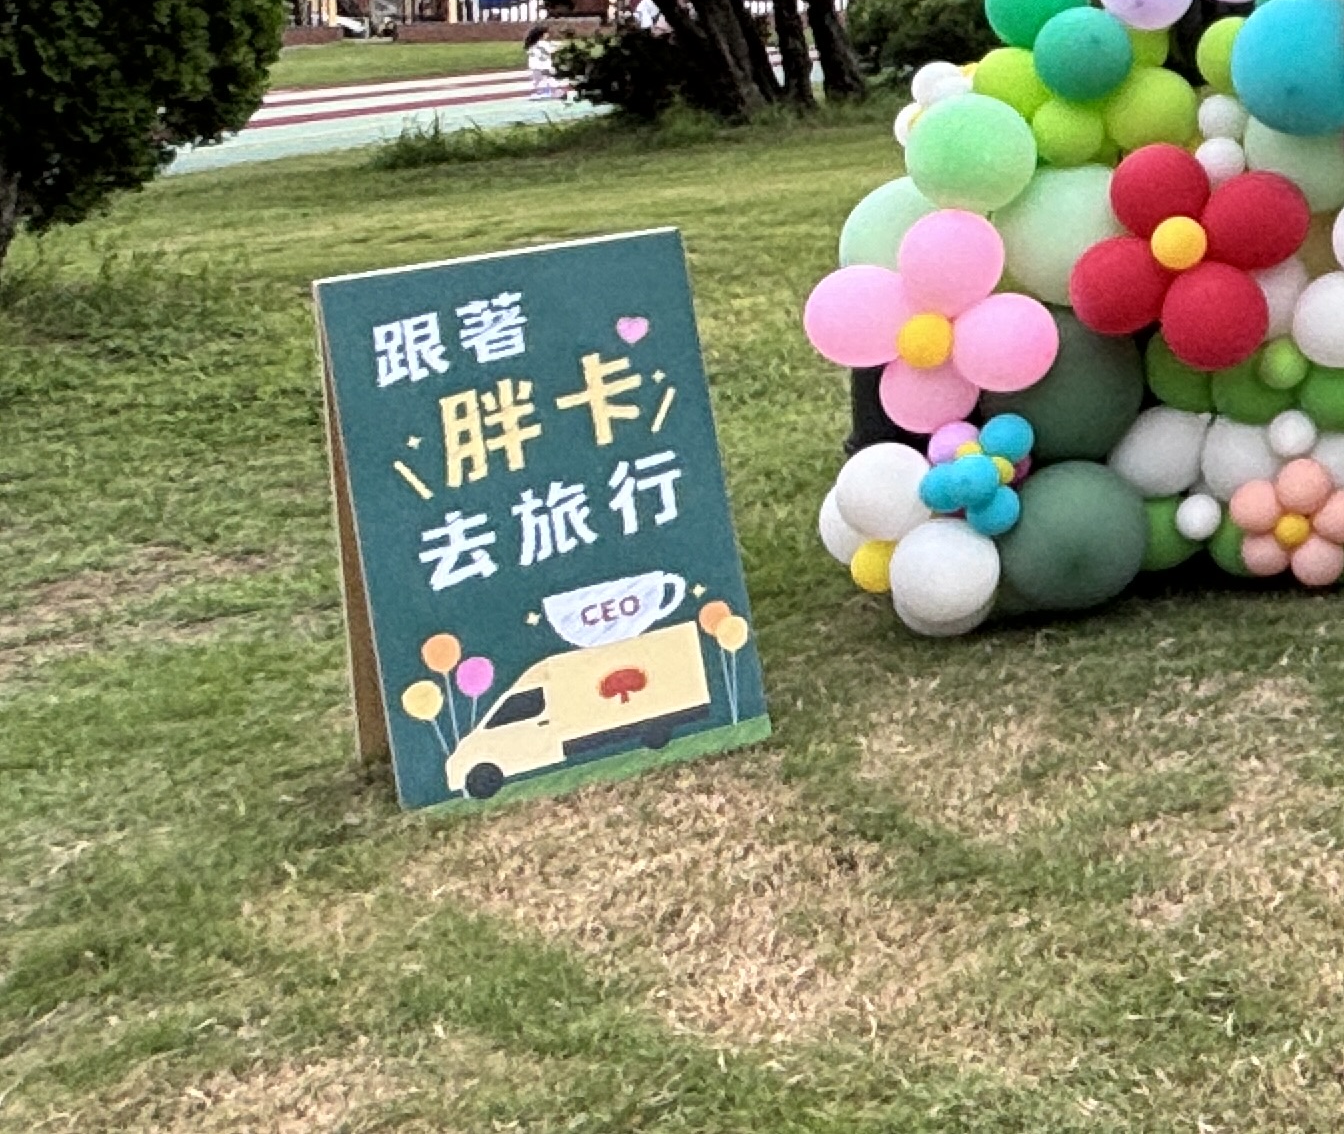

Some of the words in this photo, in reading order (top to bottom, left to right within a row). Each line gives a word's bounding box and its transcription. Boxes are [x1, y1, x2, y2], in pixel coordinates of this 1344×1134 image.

[371, 291, 529, 389] 跟著
[439, 351, 643, 489] 胖卡
[418, 450, 683, 593] 去旅行
[580, 594, 642, 628] CEO
